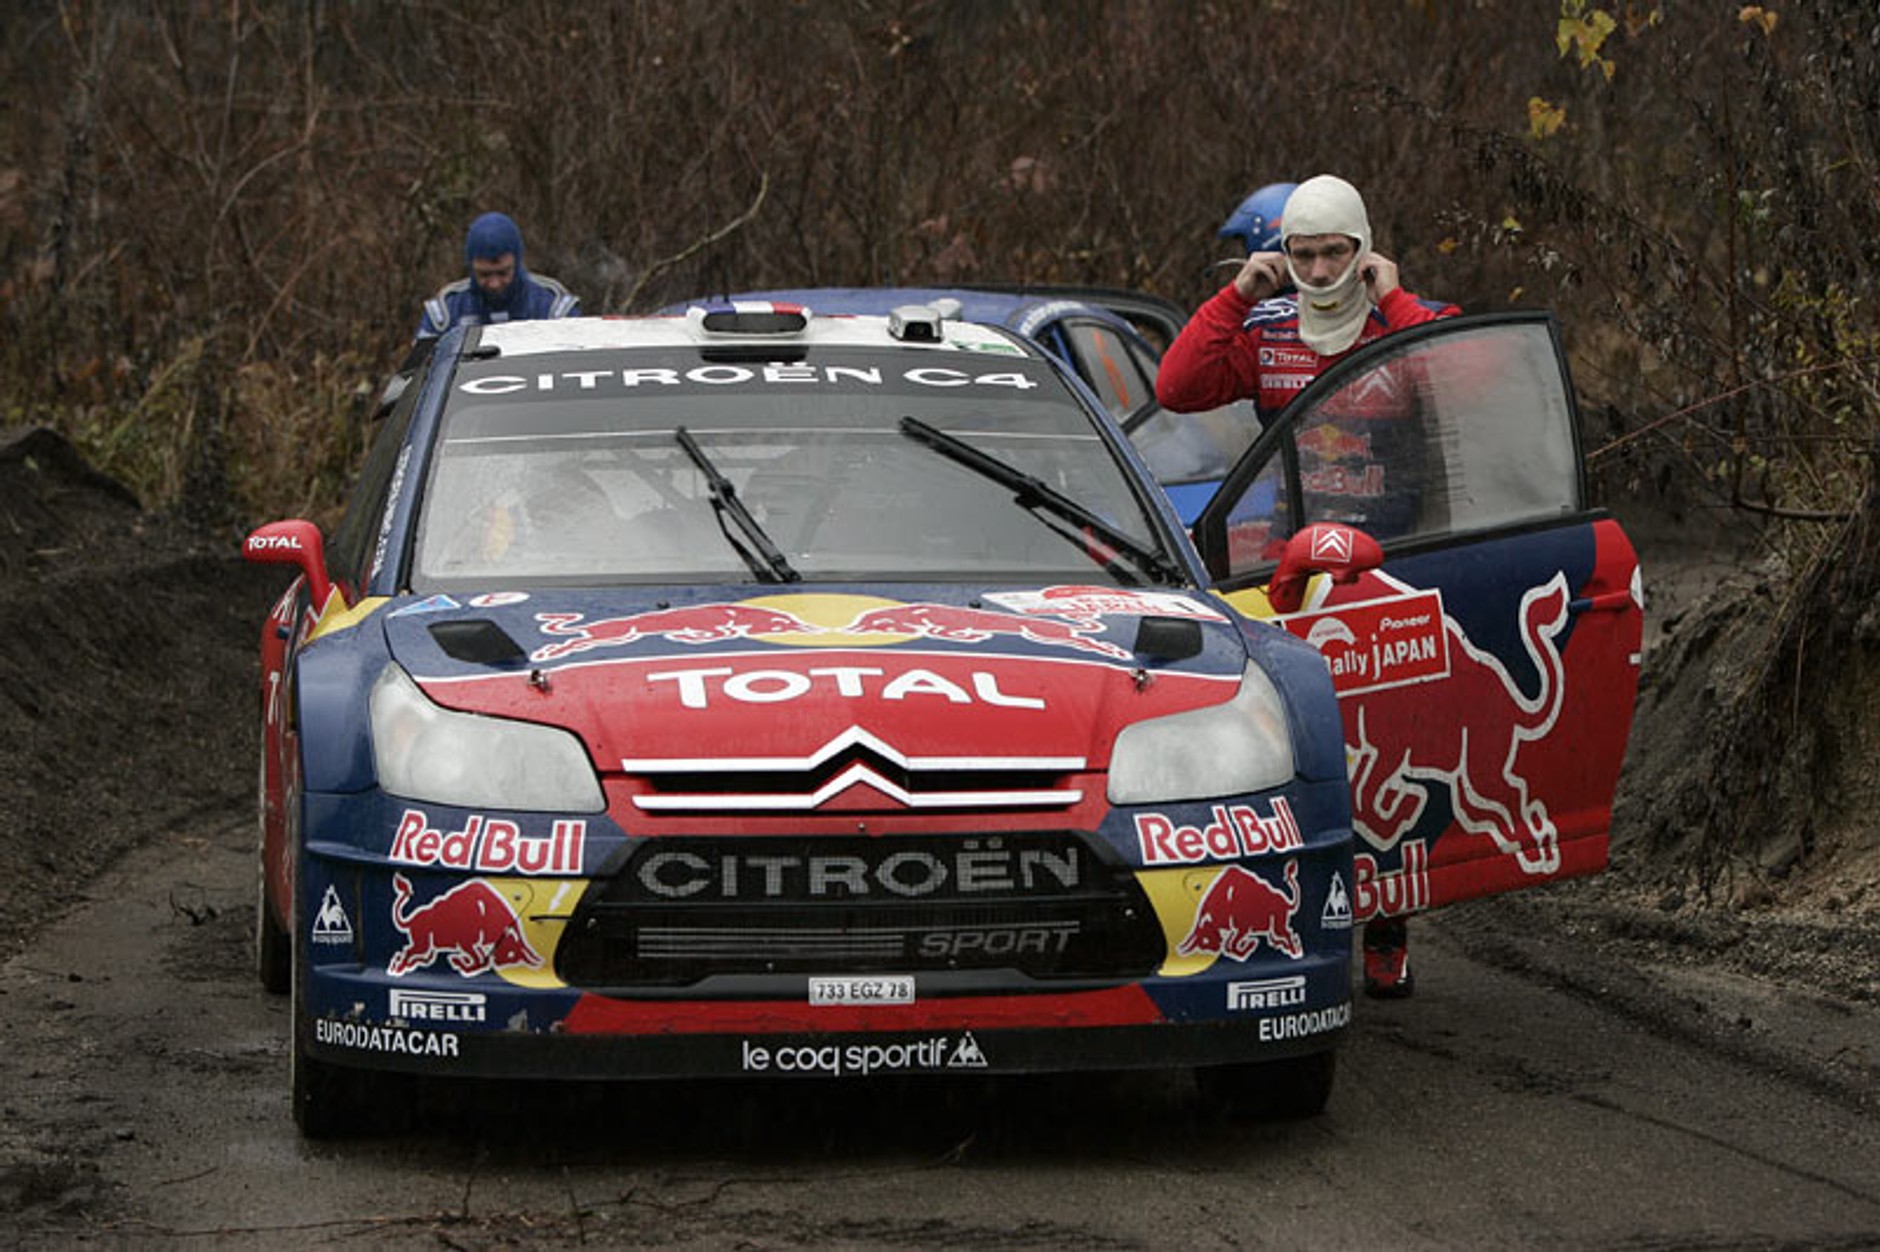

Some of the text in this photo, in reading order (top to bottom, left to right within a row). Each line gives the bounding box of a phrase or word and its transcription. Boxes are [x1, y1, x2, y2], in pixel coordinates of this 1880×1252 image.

[460, 362, 1038, 394] CITROËN C4
[248, 536, 302, 551] TOTAL
[647, 667, 1045, 708] TOTAL
[1228, 796, 1304, 857] Bull
[475, 818, 587, 874] Bull
[637, 837, 1079, 897] CITROËN
[1353, 838, 1429, 923] Bull
[918, 928, 1080, 957] SPORT
[390, 989, 486, 1021] PIRELLI
[816, 982, 909, 999] 733 EGZ 78
[1227, 976, 1306, 1010] PIRELLI
[317, 1019, 459, 1056] EURODATACAR
[743, 1037, 948, 1076] le coq sportif
